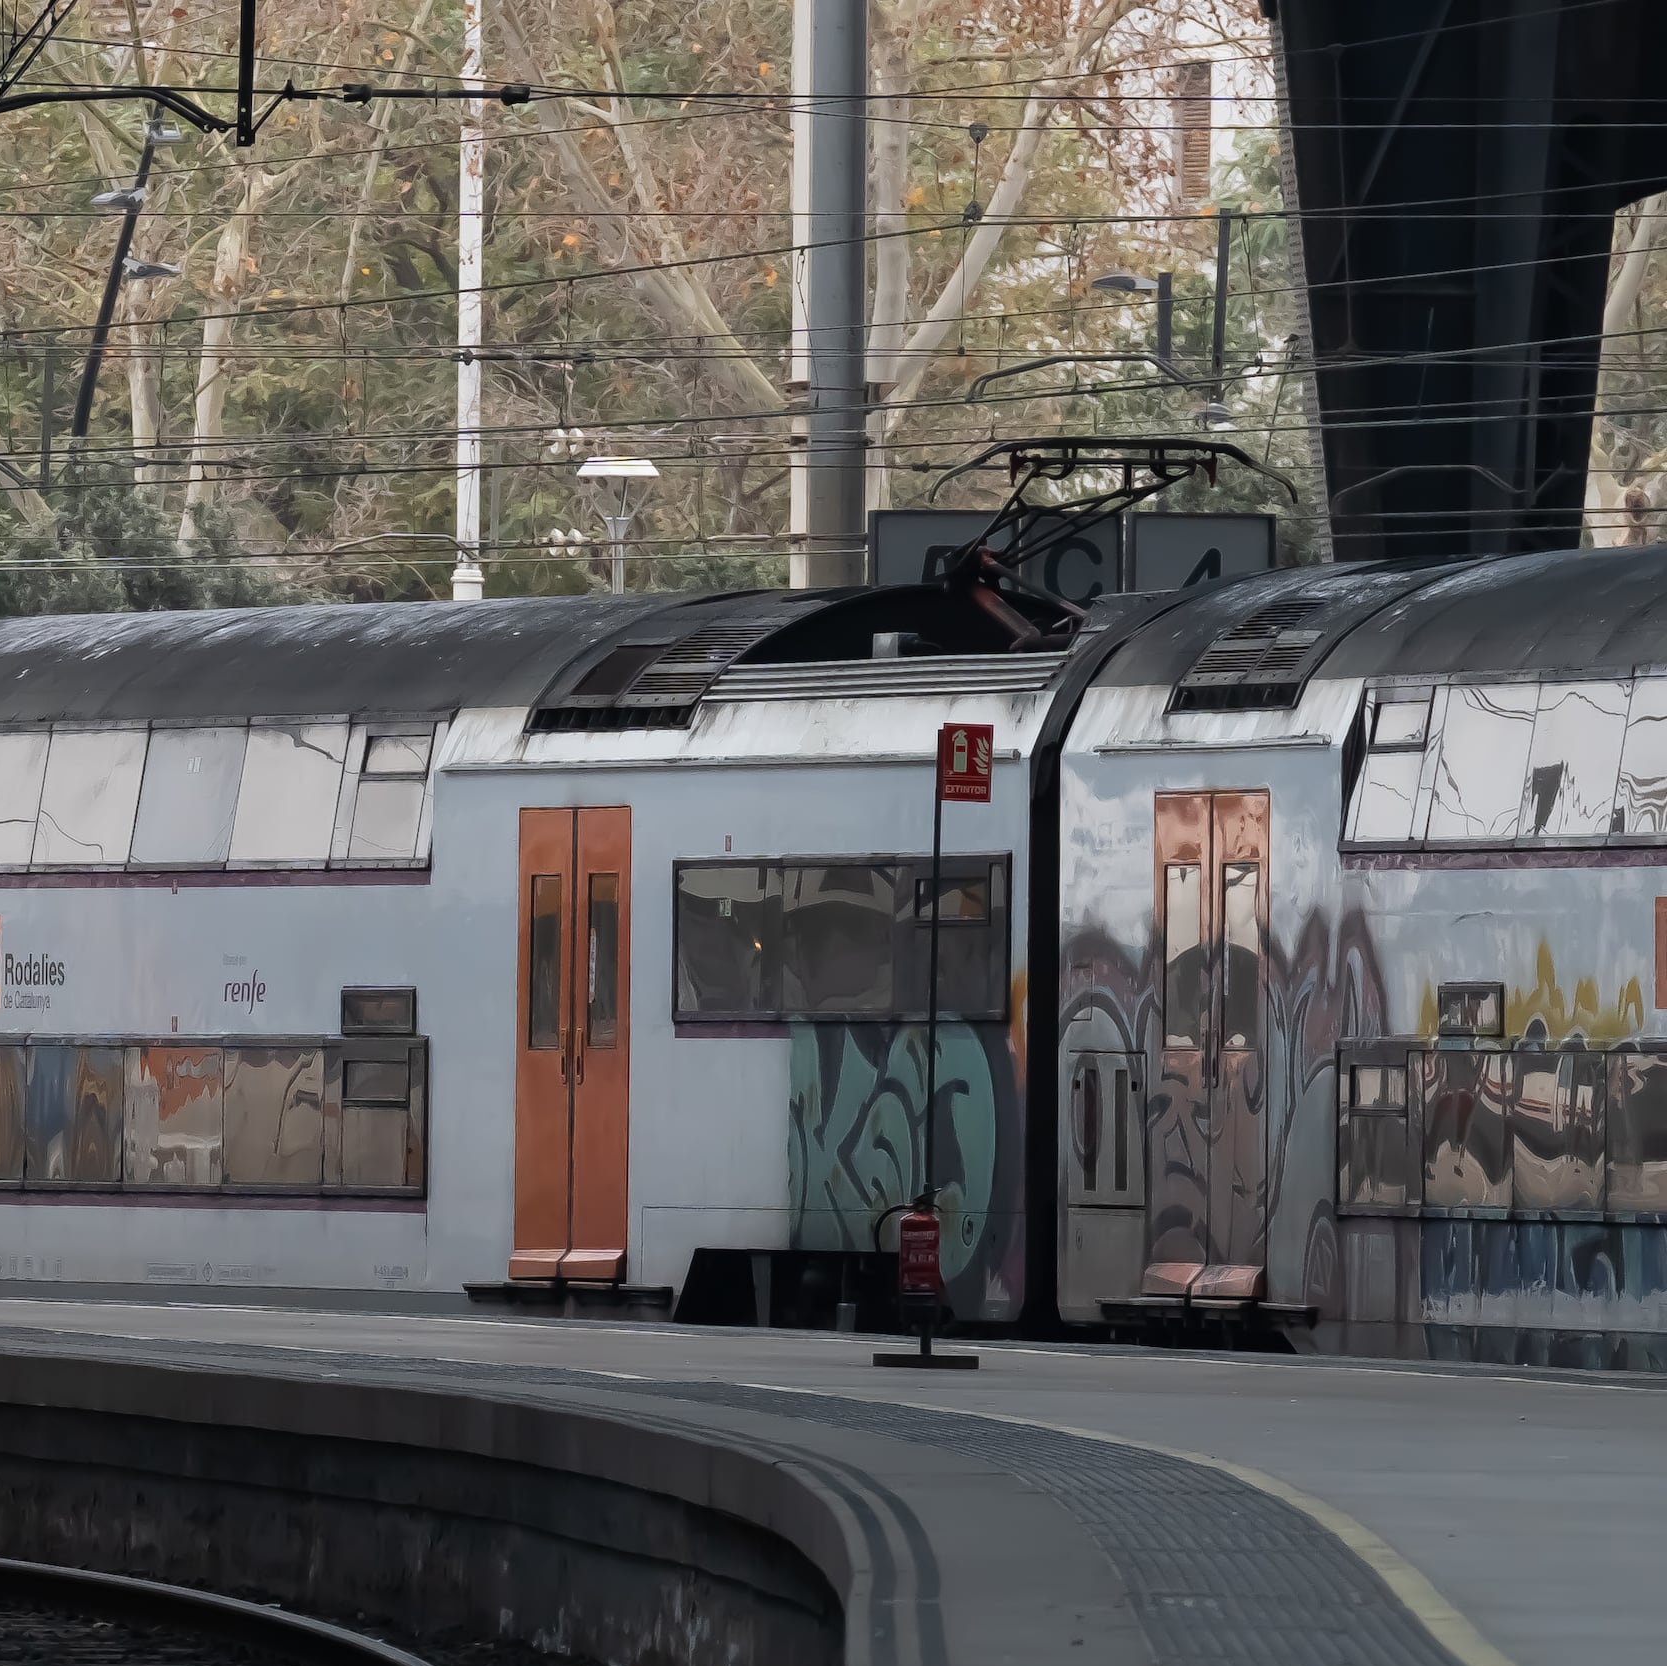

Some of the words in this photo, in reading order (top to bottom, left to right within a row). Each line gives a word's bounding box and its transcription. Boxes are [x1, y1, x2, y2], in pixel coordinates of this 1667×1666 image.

[945, 784, 987, 795] EXTINTOR
[4, 952, 65, 987] Rodalies
[3, 991, 14, 1009] de
[224, 968, 267, 1014] renfe
